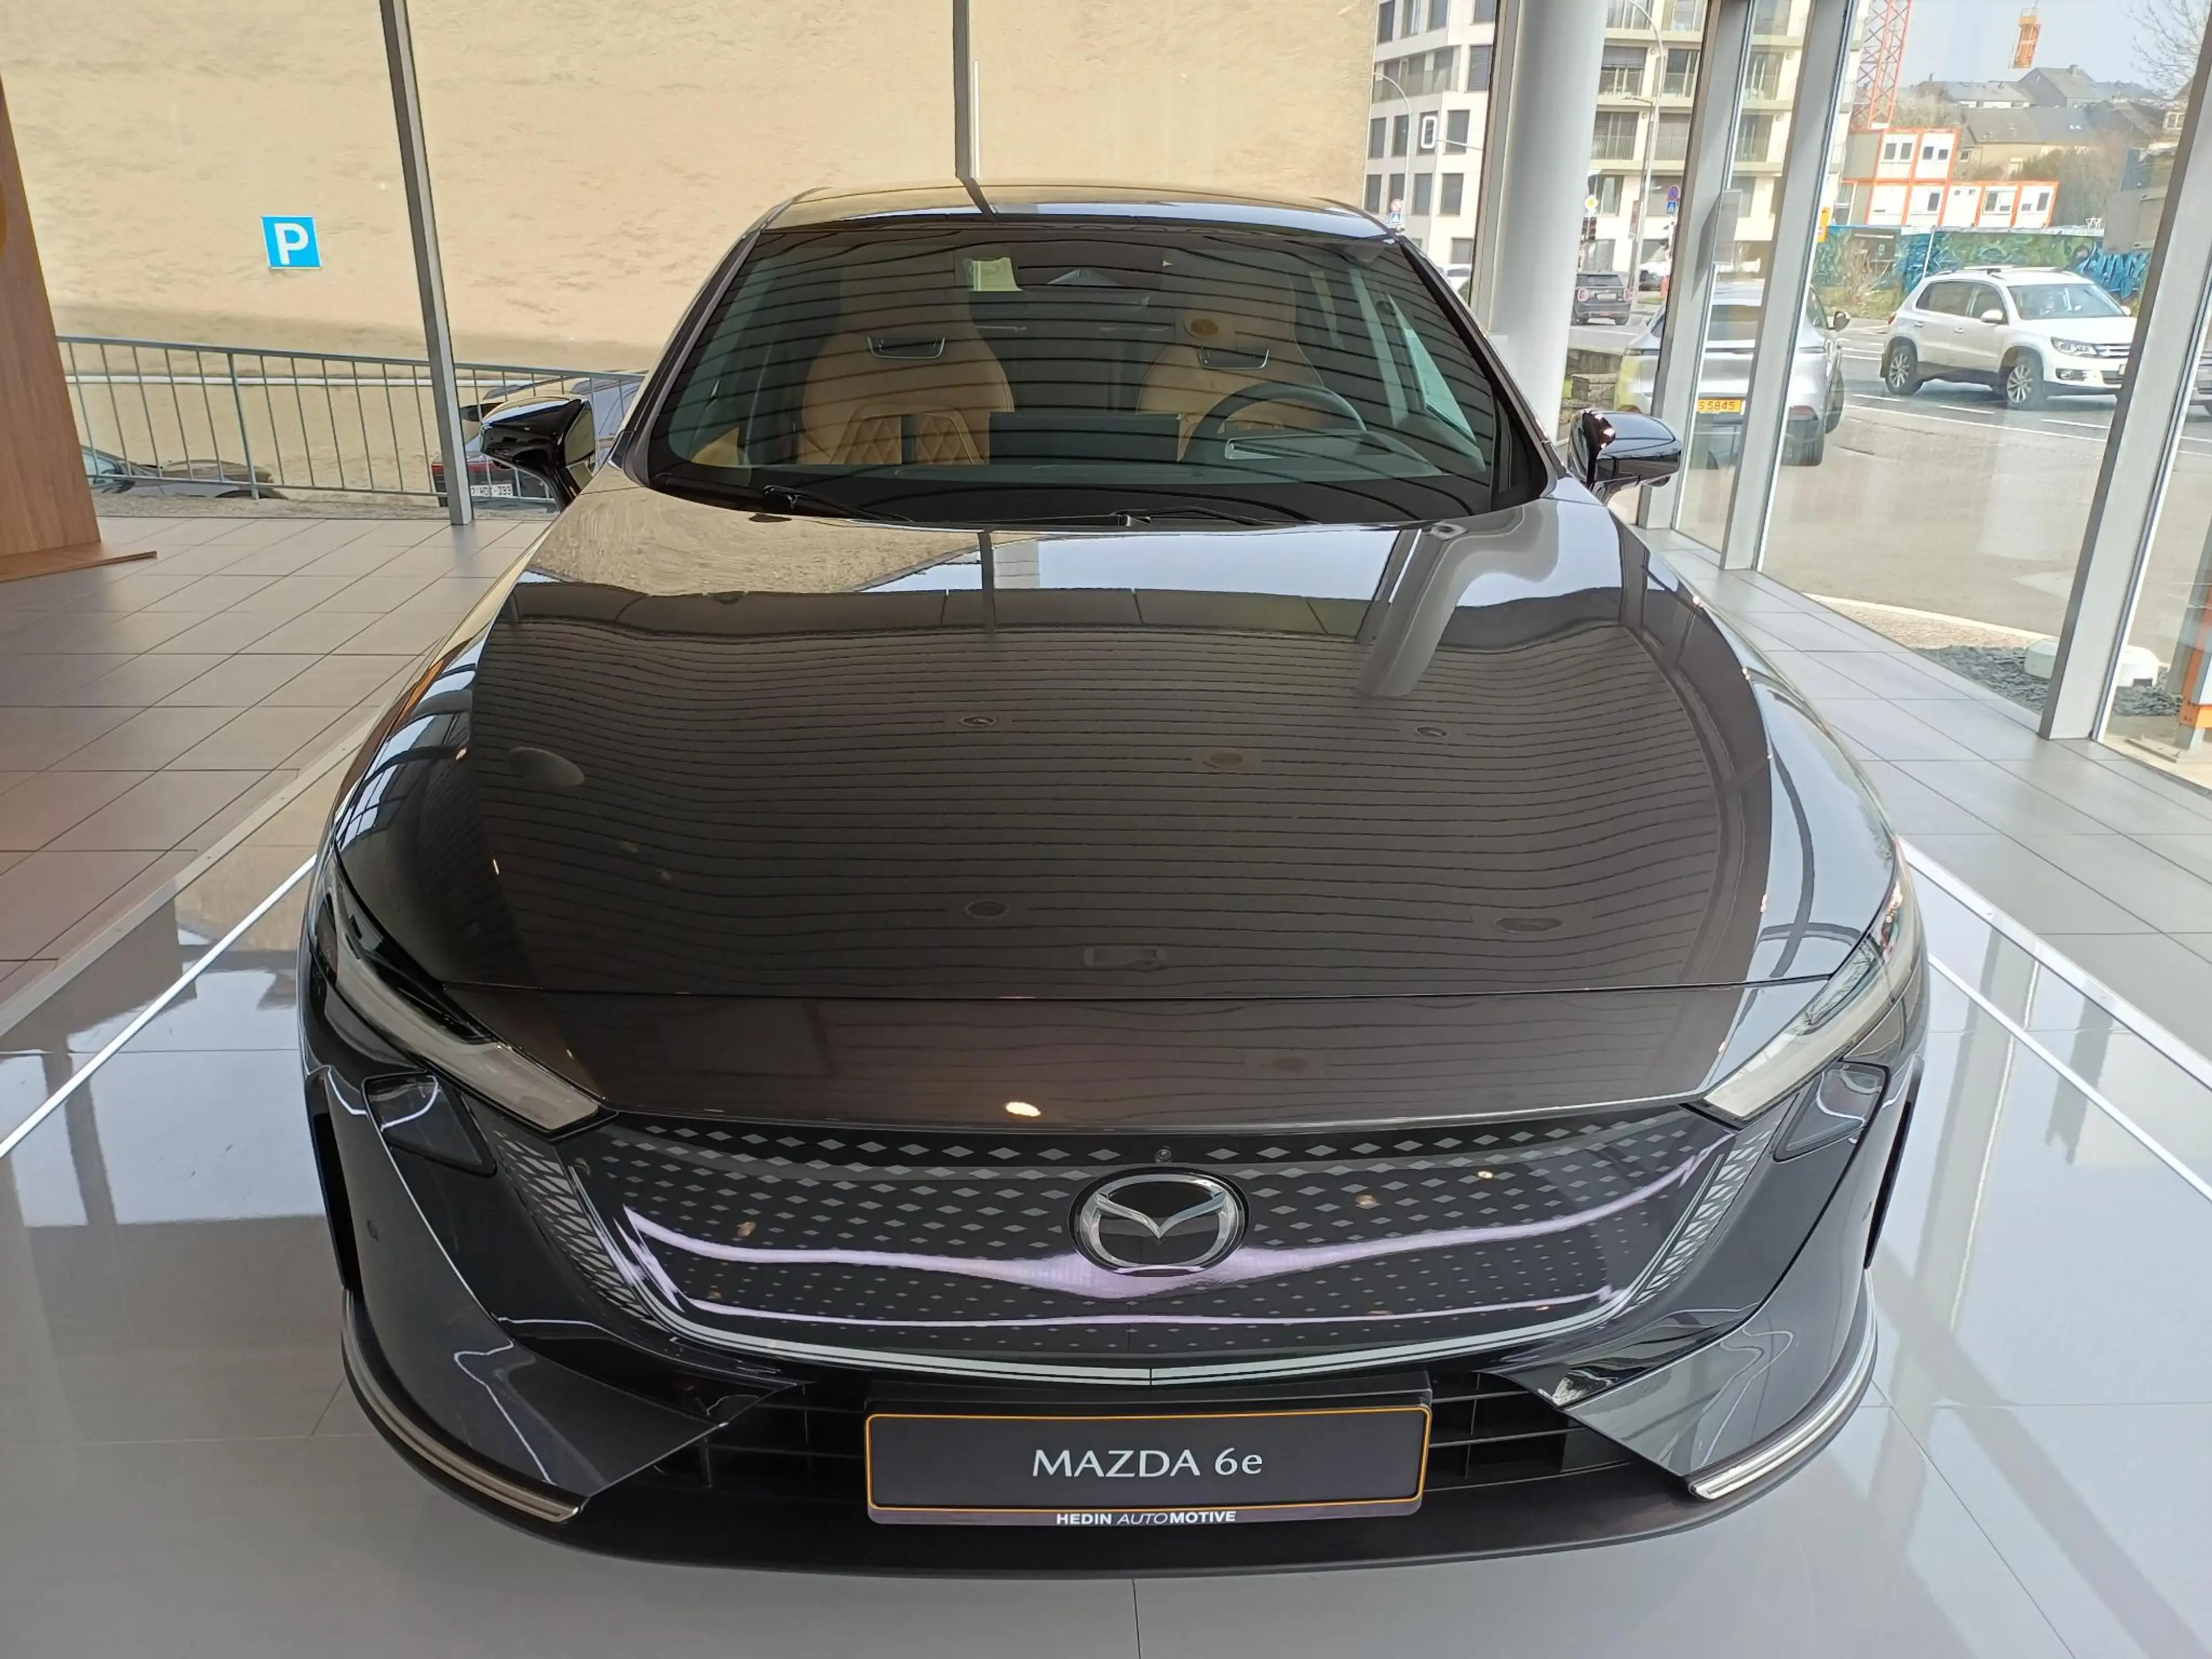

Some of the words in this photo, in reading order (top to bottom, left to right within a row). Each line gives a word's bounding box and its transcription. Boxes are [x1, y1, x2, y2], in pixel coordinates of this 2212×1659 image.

[274, 222, 309, 265] P
[1032, 1449, 1201, 1478] MAZDA
[1214, 1447, 1263, 1475] 6e
[1056, 1513, 1112, 1525] HEDIN
[1116, 1511, 1236, 1525] AUTOMOTIVE
